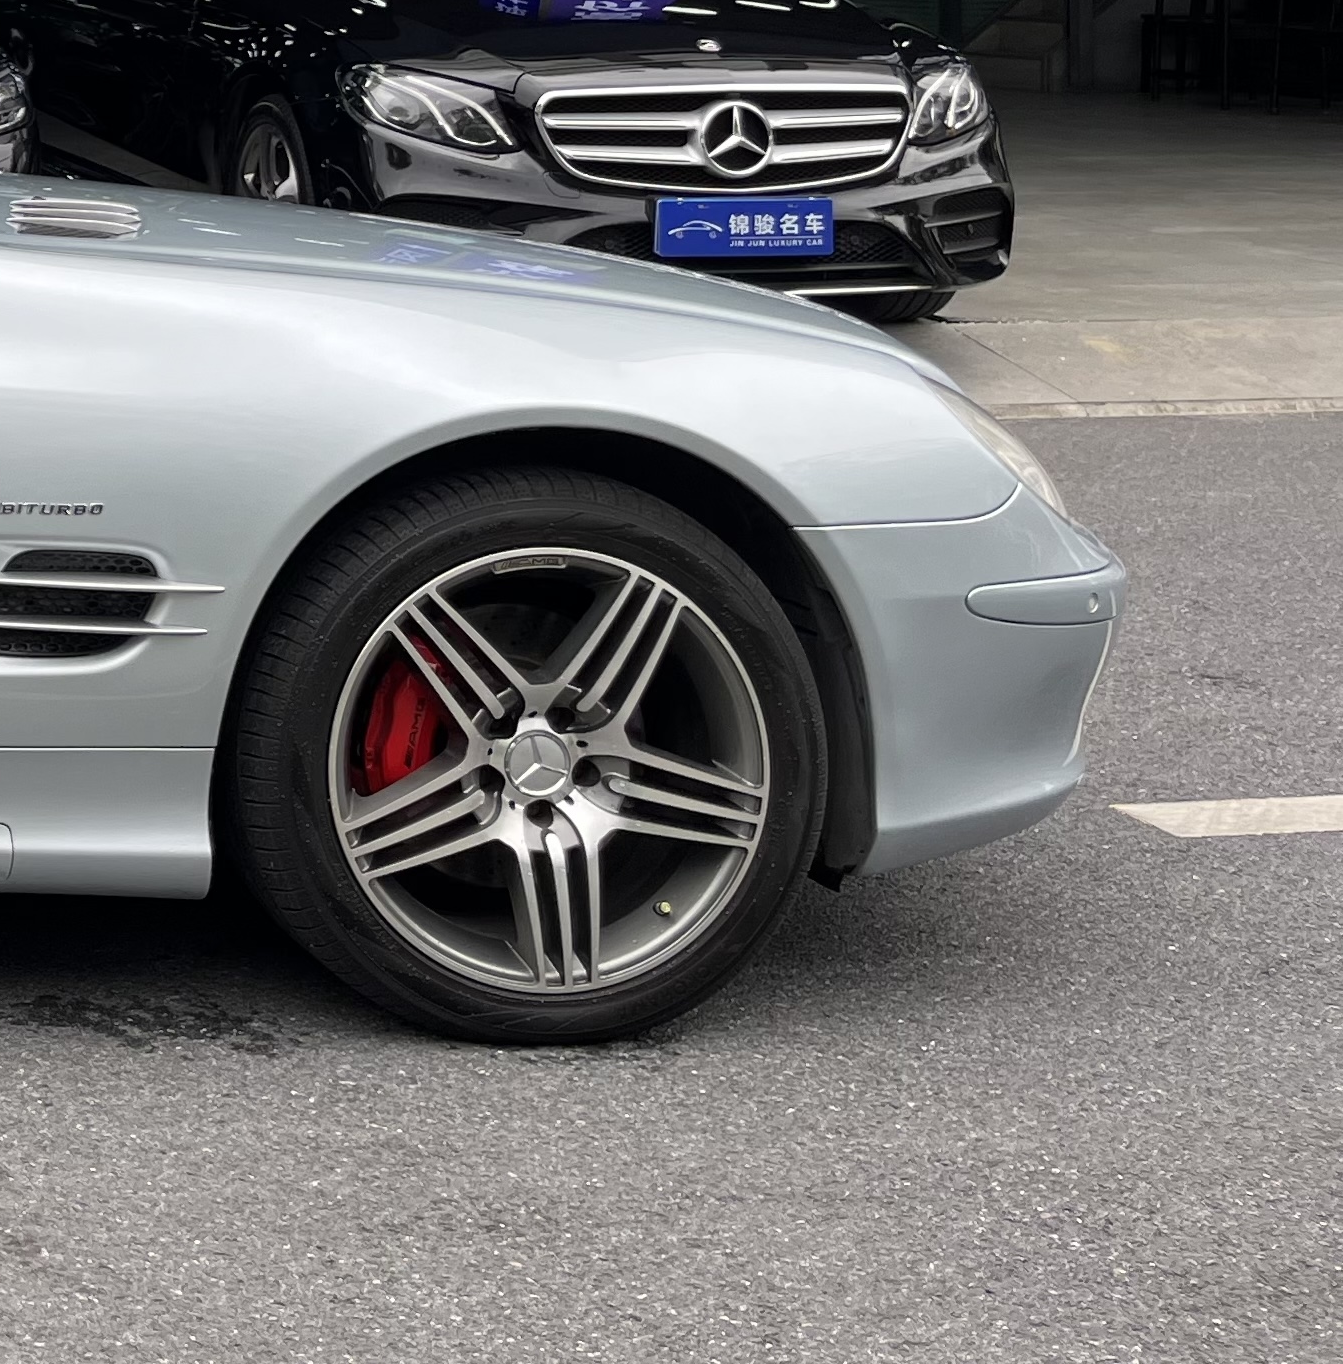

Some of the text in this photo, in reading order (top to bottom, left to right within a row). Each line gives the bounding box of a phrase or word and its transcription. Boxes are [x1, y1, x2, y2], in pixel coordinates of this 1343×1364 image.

[728, 212, 825, 236] 锦骏名车
[769, 239, 803, 247] LUXURY
[806, 238, 823, 246] CAR
